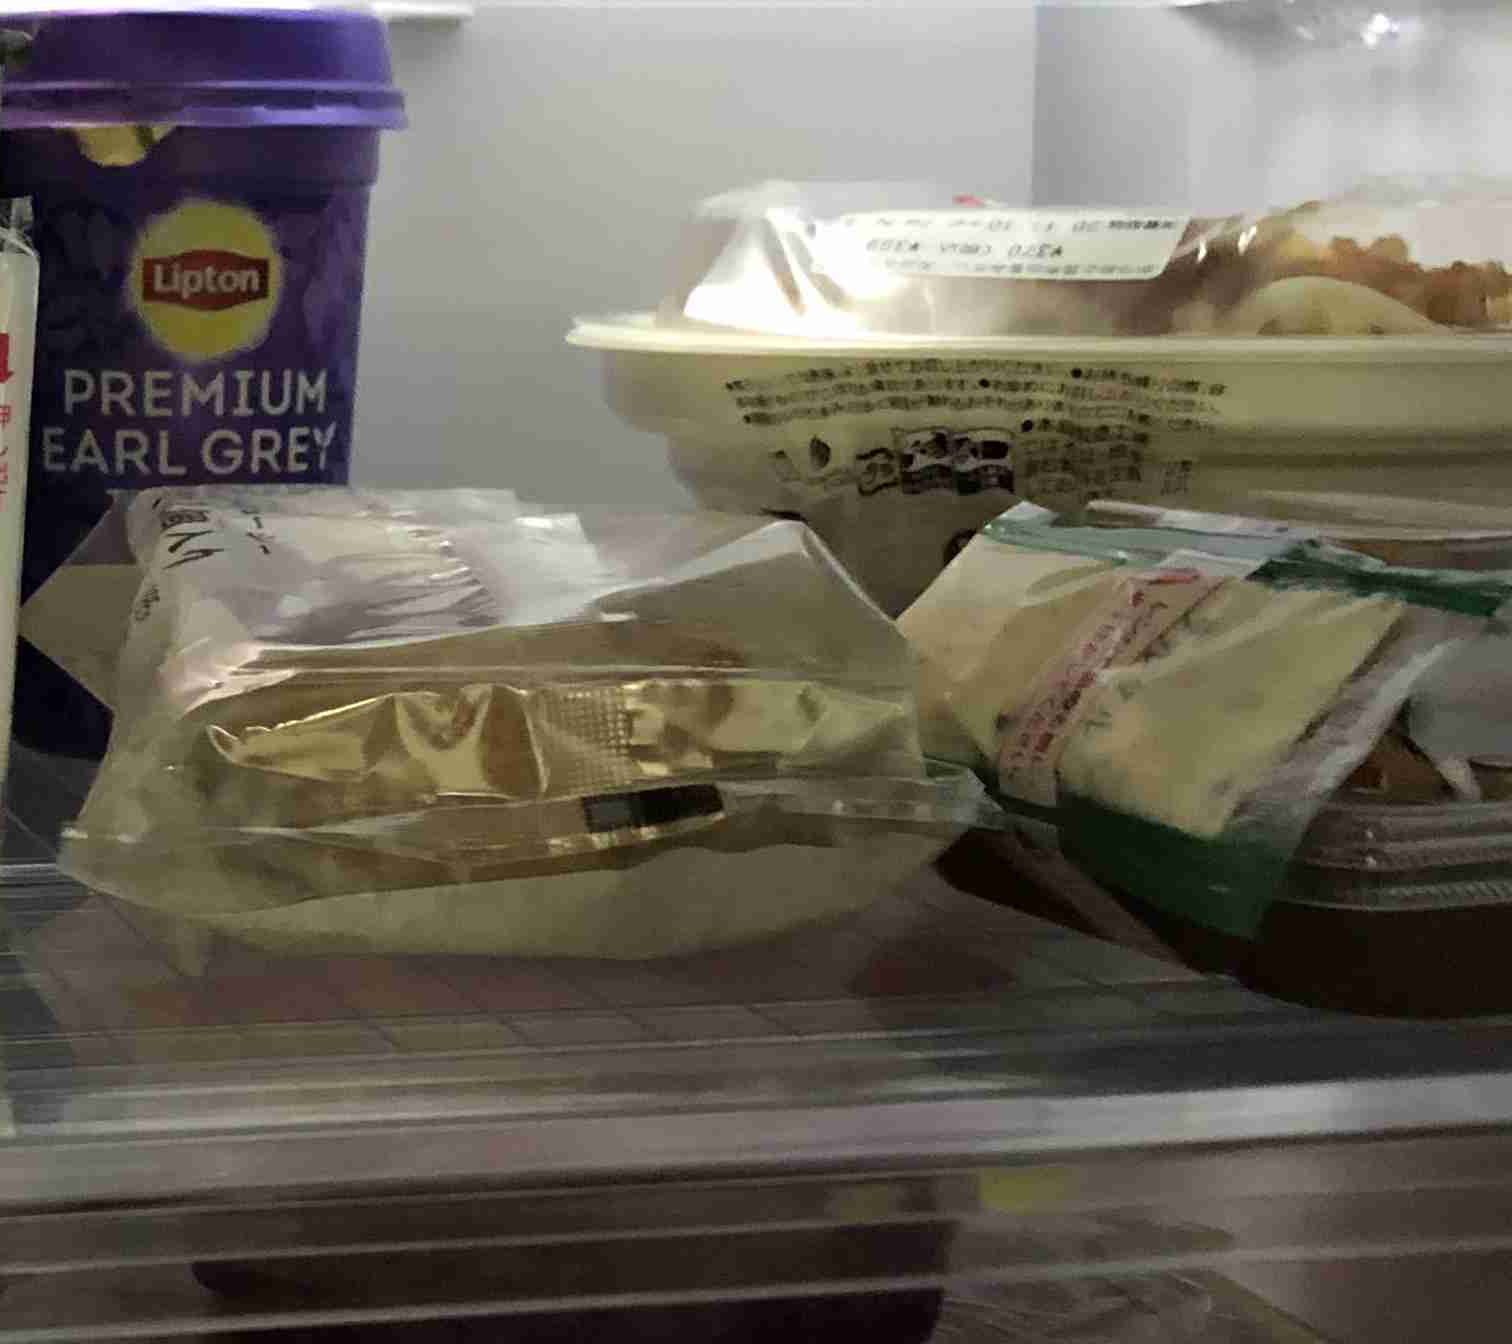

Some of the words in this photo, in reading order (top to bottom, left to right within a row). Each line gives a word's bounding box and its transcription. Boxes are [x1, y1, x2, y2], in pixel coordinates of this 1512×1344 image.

[152, 263, 262, 298] Lipton
[64, 369, 329, 419] PREMIUM
[40, 424, 187, 476] EARL
[201, 421, 338, 475] GREY
